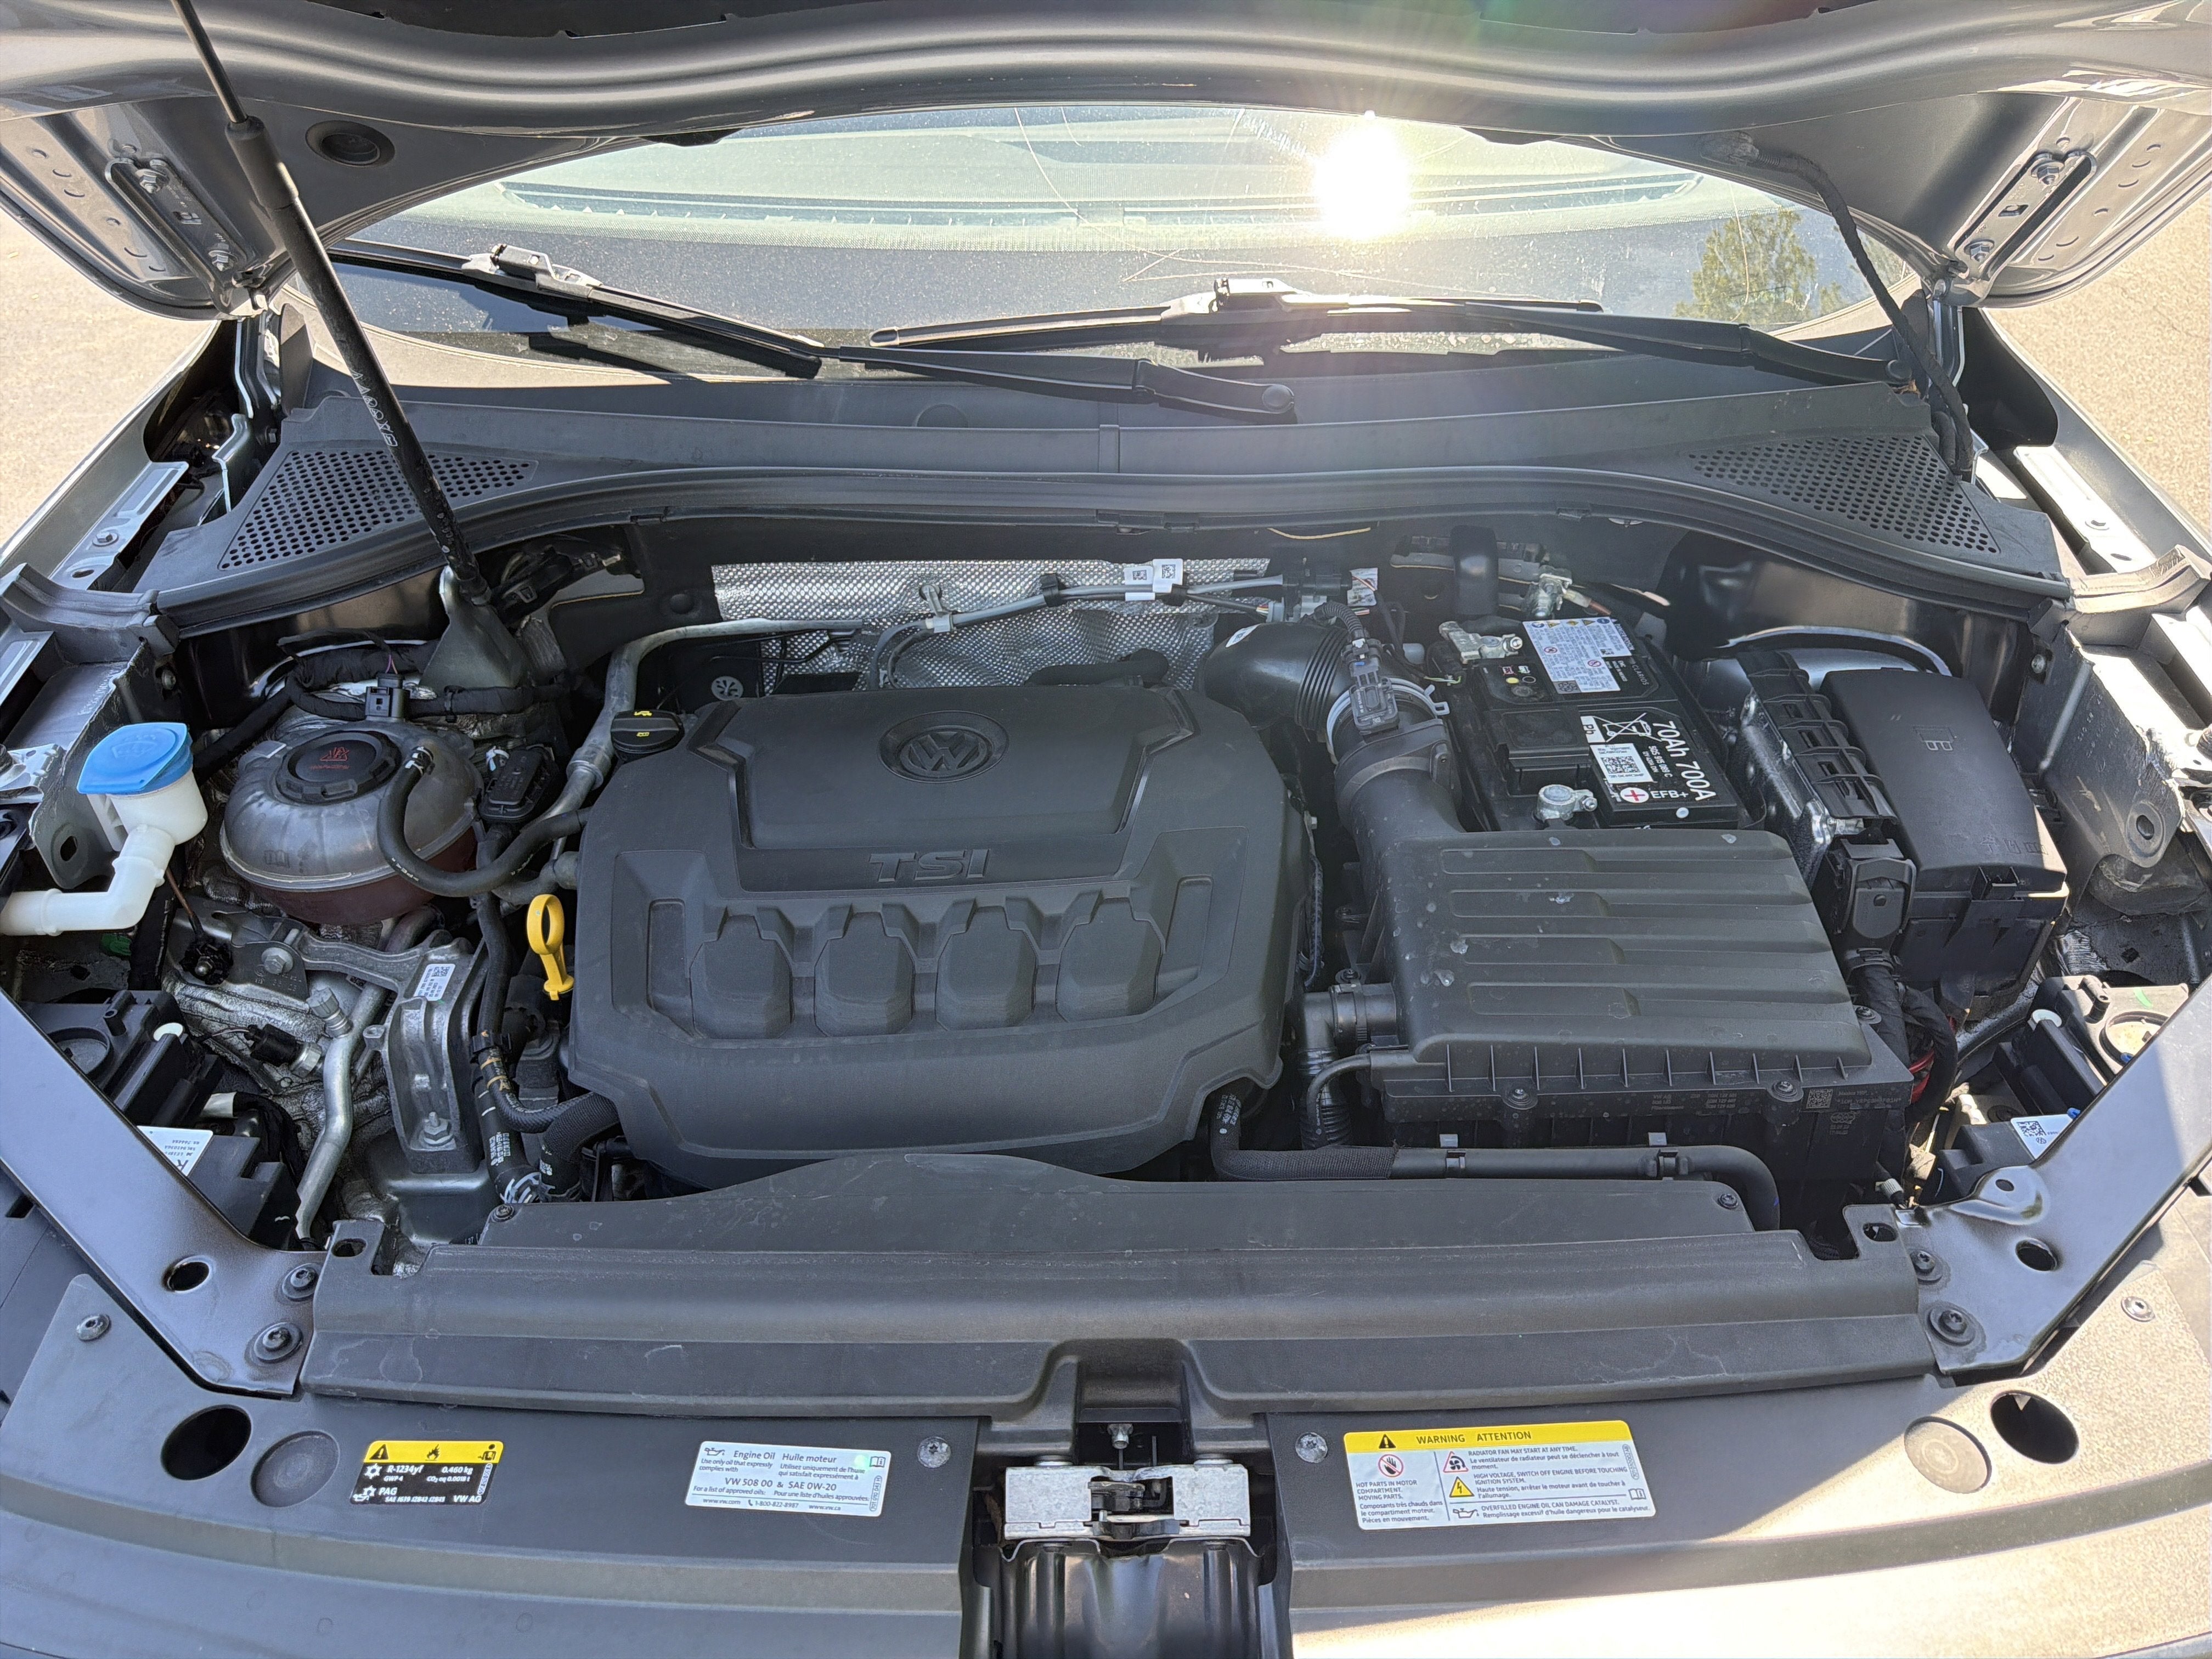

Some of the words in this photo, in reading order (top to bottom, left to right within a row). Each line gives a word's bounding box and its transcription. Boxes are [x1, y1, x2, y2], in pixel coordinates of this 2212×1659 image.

[1632, 665, 1649, 685] CLARIOS
[1653, 721, 1690, 757] 70Ah
[1675, 761, 1717, 801] 700A
[1650, 790, 1689, 799] EFB+
[869, 849, 990, 882] TSI
[1416, 1434, 1465, 1444] WARNING
[1477, 1431, 1531, 1442] ATTENTION
[733, 1451, 762, 1460] Engine
[782, 1453, 804, 1462] Huile
[386, 1465, 424, 1475] R-1234yf
[464, 1466, 473, 1475] kg
[724, 1477, 741, 1485] VW
[788, 1481, 805, 1489] SAE
[806, 1482, 837, 1491] 0W-20
[379, 1487, 397, 1496] PAG
